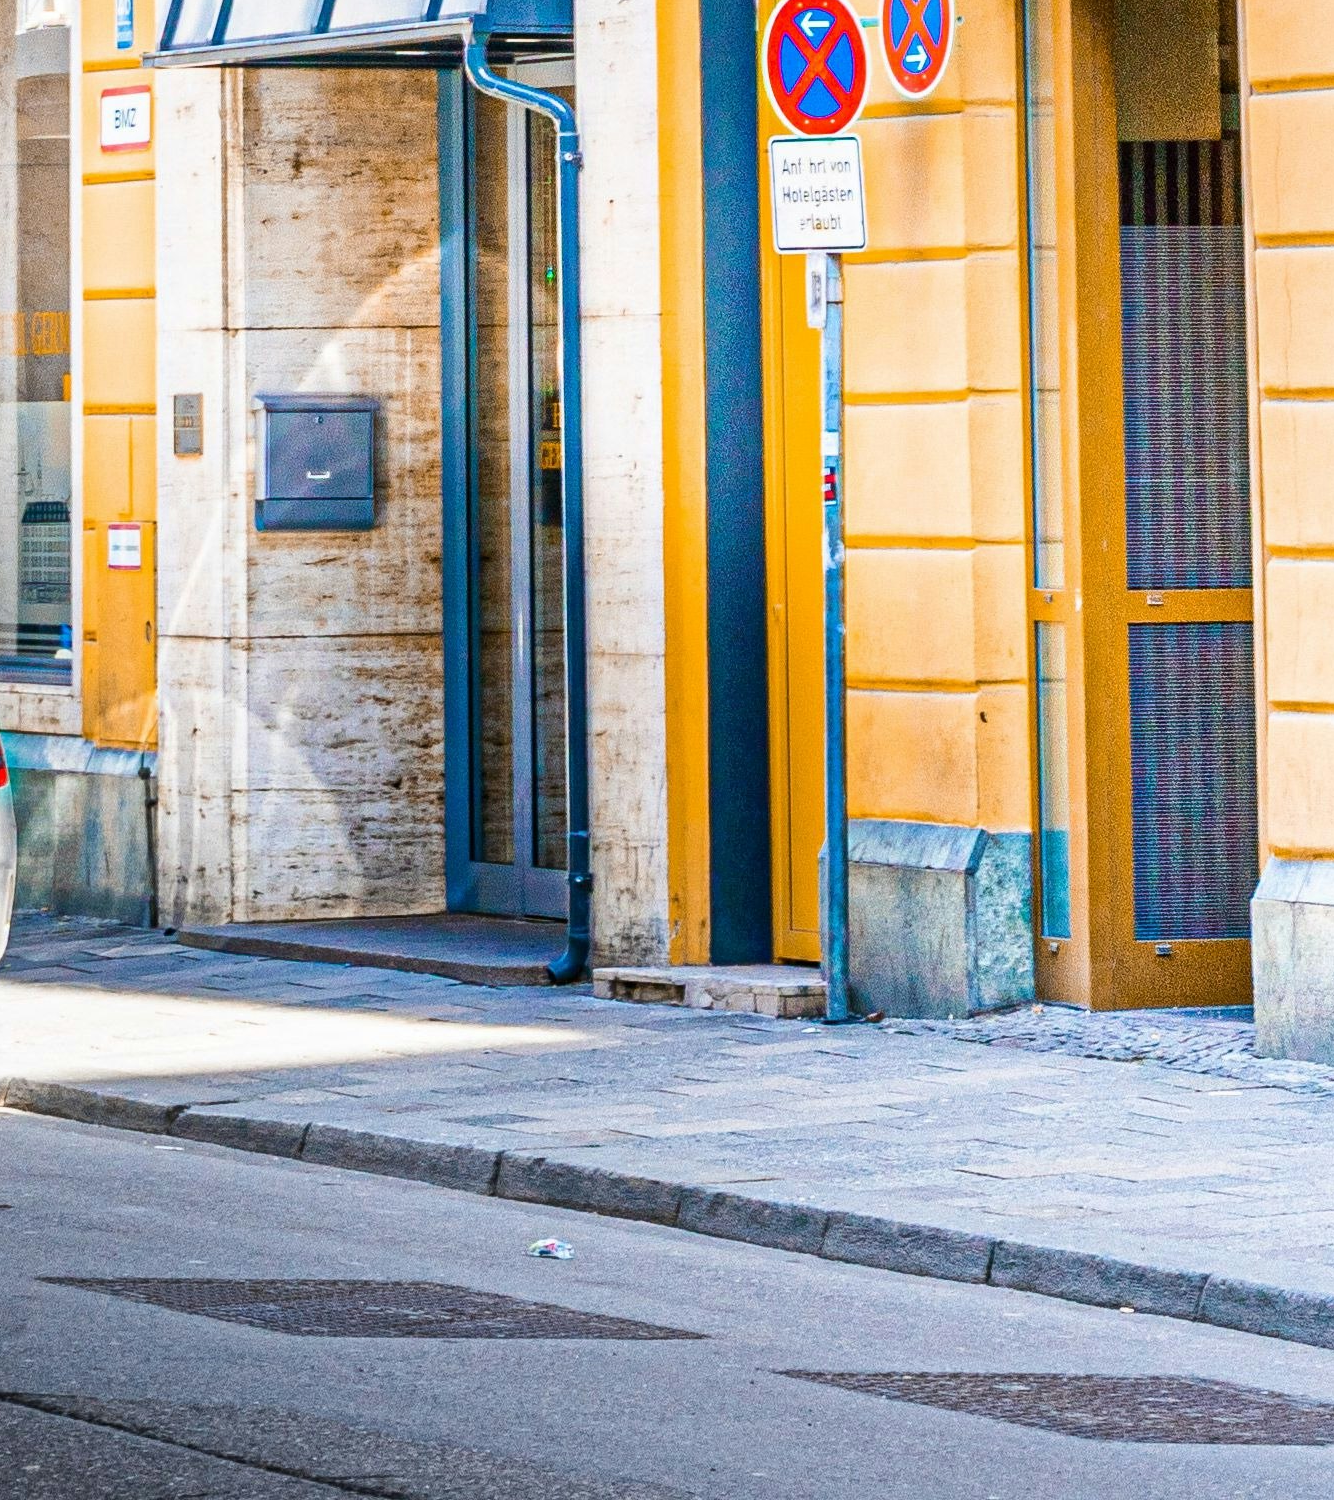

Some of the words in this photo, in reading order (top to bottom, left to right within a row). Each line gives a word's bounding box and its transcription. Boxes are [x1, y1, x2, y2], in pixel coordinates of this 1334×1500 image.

[115, 107, 137, 129] BMZ
[782, 157, 826, 176] Anfhrt
[830, 160, 852, 174] von
[782, 186, 854, 208] Hotelgästen
